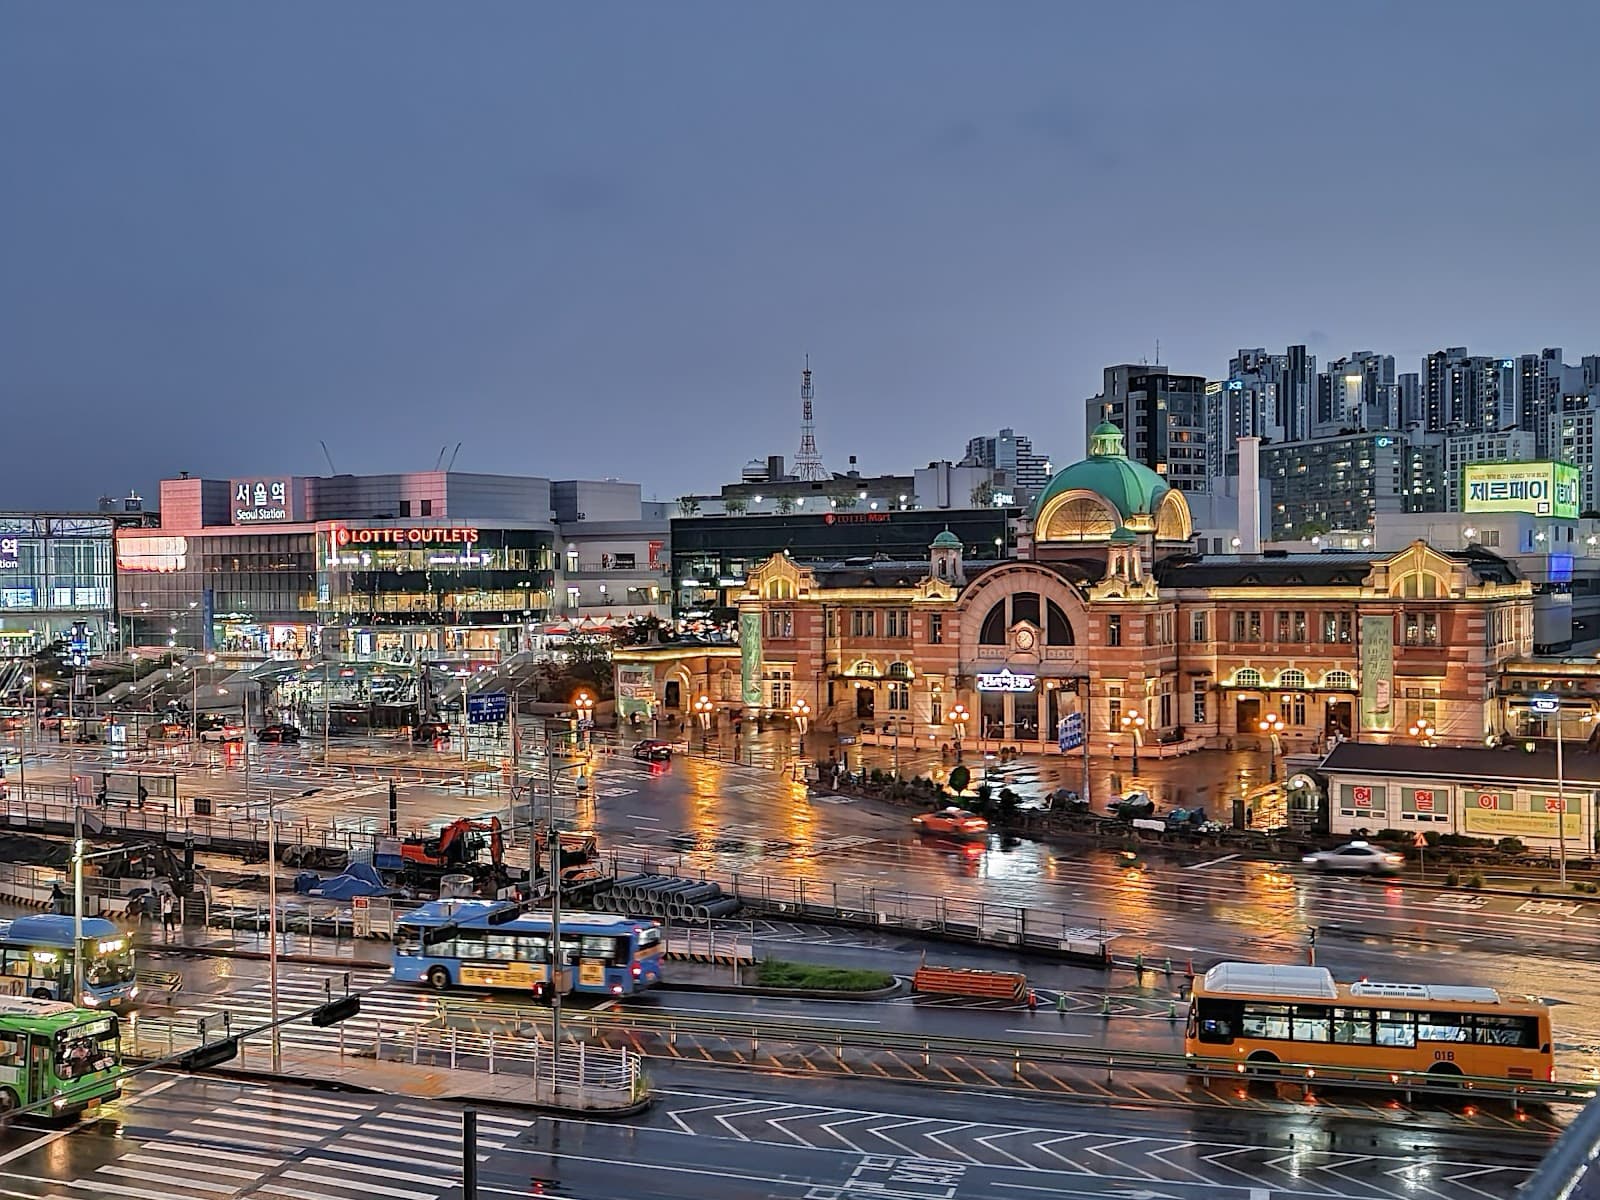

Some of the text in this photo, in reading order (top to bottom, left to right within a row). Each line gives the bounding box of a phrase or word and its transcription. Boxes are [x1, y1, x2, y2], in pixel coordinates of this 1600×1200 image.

[236, 482, 286, 506] 서울역
[1470, 480, 1548, 501] 제로페이
[236, 507, 286, 520] Seoul Station
[838, 513, 892, 523] LOTTE Mart
[351, 528, 479, 543] LOTTE OUTLETS
[1434, 1050, 1455, 1062] 01B
